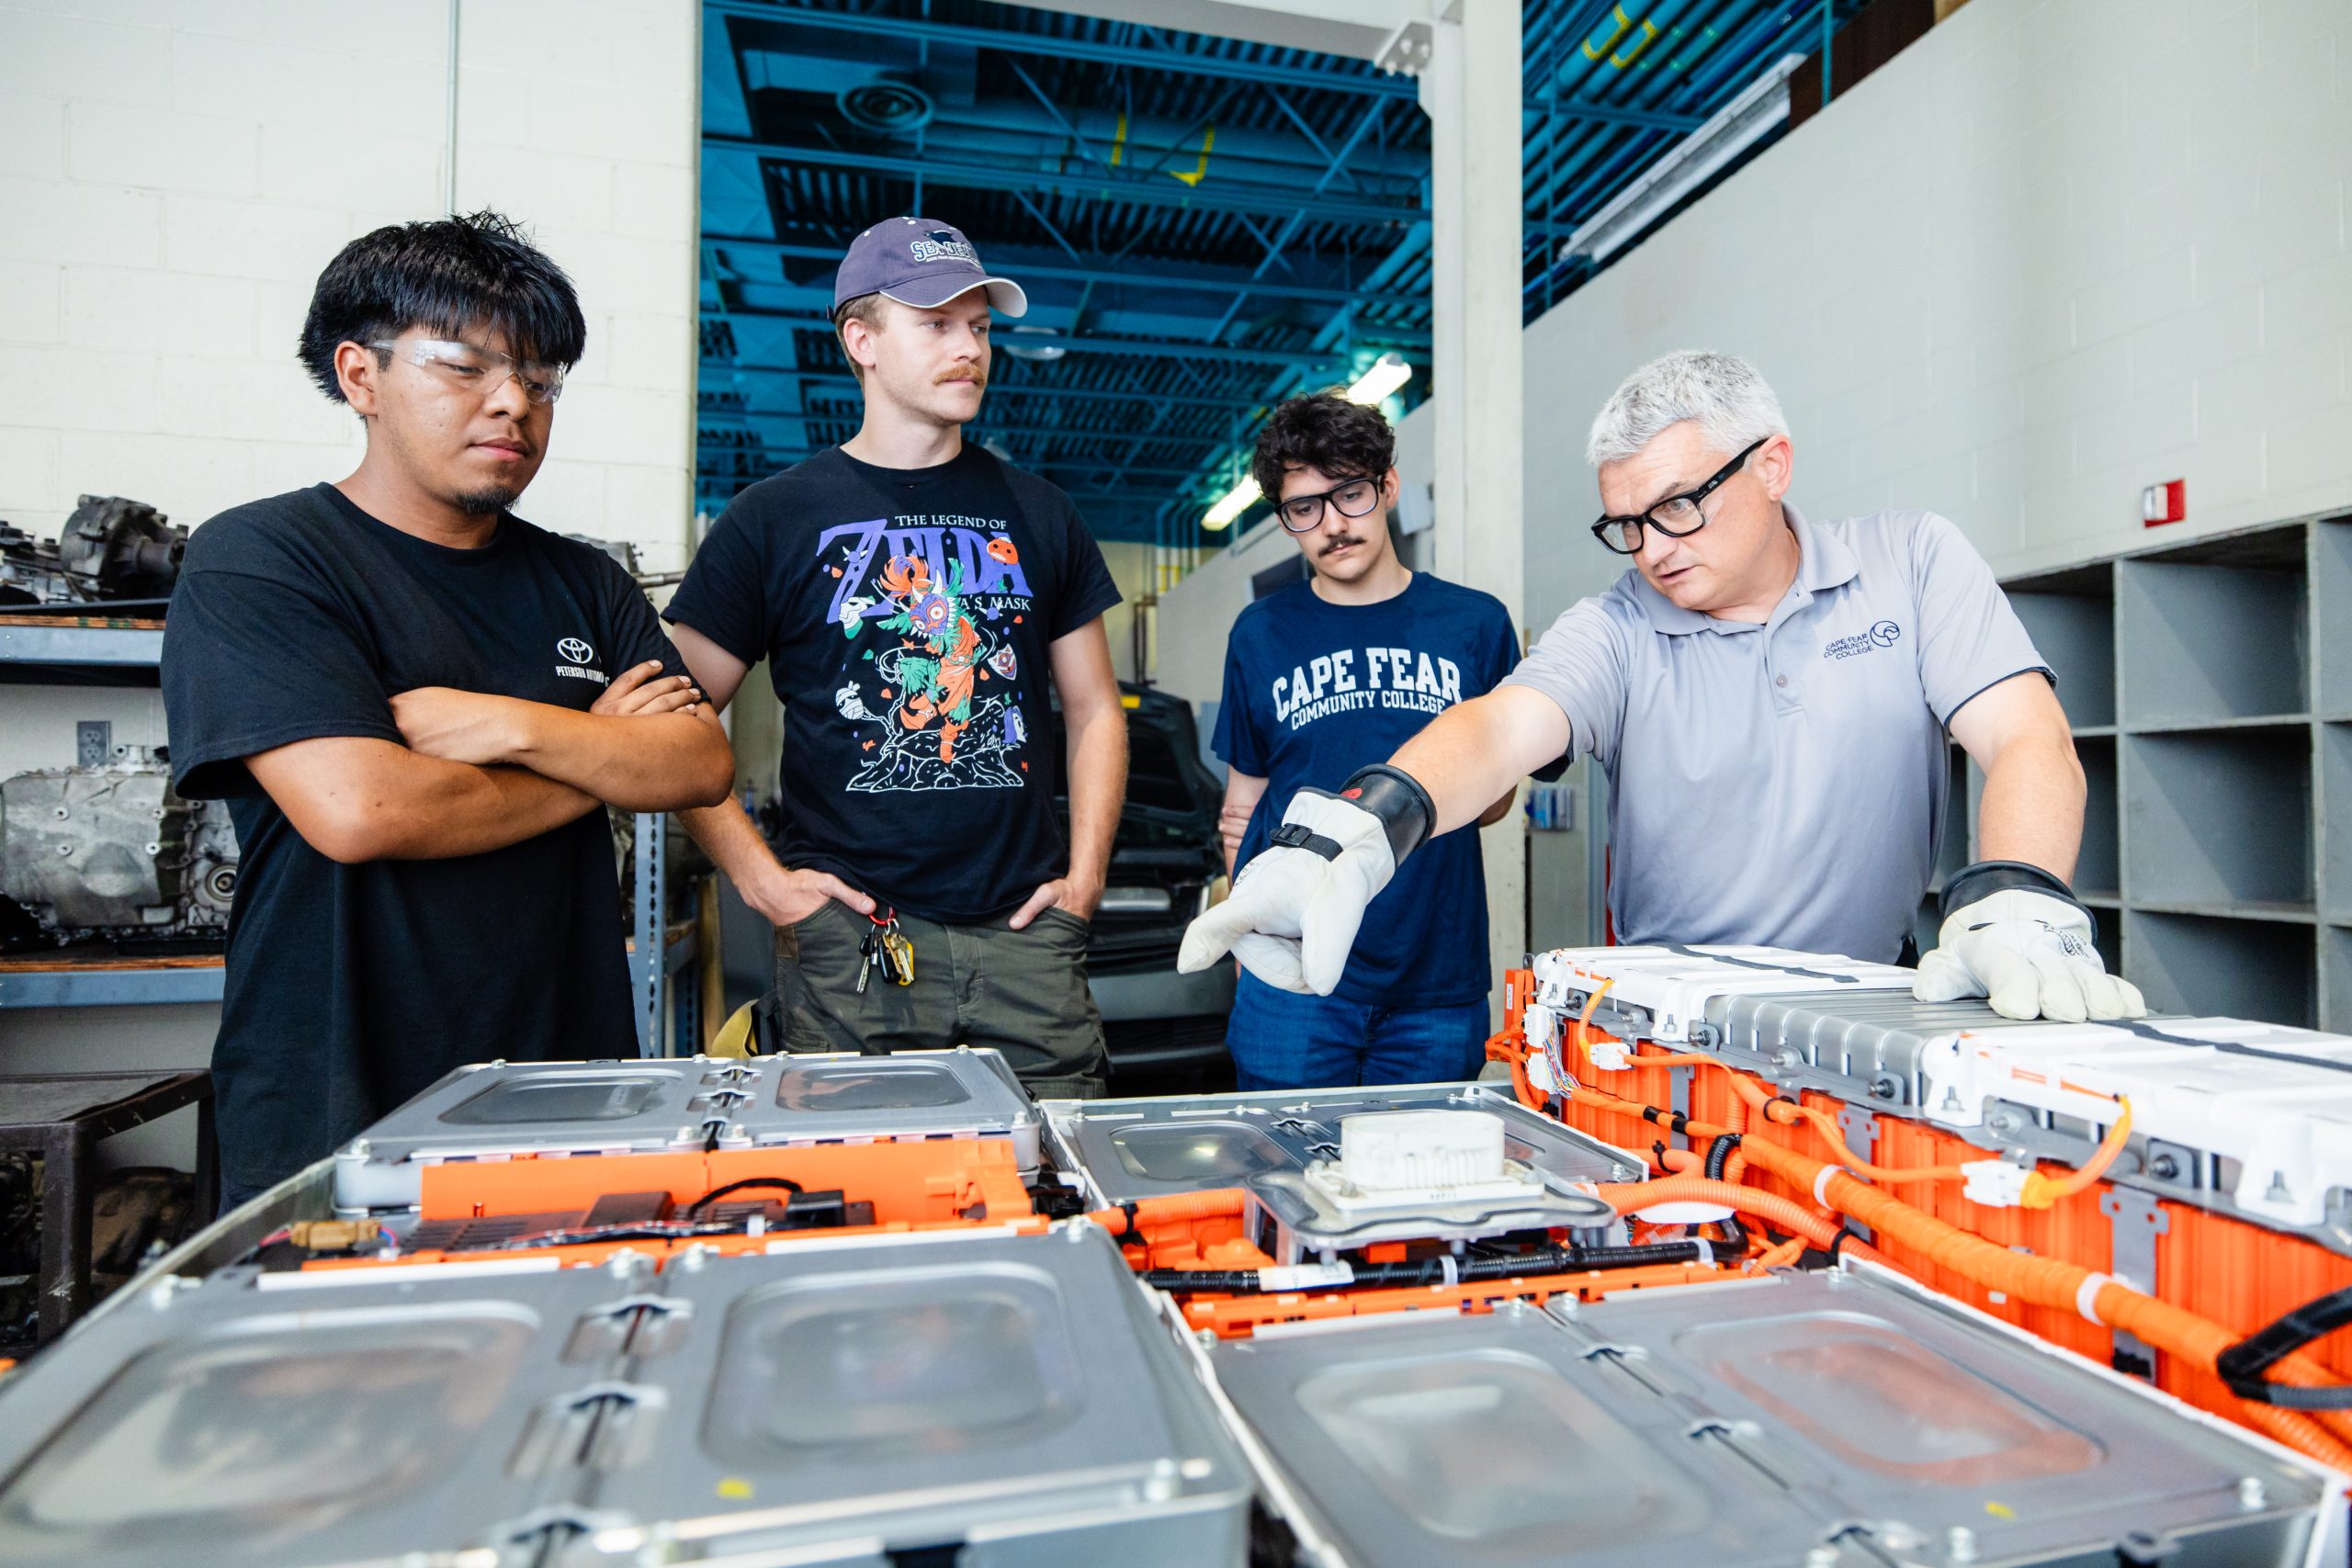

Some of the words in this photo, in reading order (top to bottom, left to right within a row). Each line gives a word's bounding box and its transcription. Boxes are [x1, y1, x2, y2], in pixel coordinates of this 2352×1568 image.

[910, 241, 944, 262] SEA
[895, 515, 927, 526] THE
[932, 514, 986, 528] LEGEND
[989, 519, 1007, 530] OF
[816, 518, 1034, 624] ZELDA
[990, 596, 1031, 612] MASK
[1824, 639, 1870, 659] COMMUNITY
[1826, 637, 1846, 651] CAPE
[1848, 633, 1868, 643] FEAR
[1836, 645, 1874, 660] COLLEGE
[1272, 649, 1356, 723] CAPE
[1365, 648, 1463, 705] FEAR
[1291, 691, 1375, 731] COMMUNITY
[1382, 690, 1445, 715] COLLEGE
